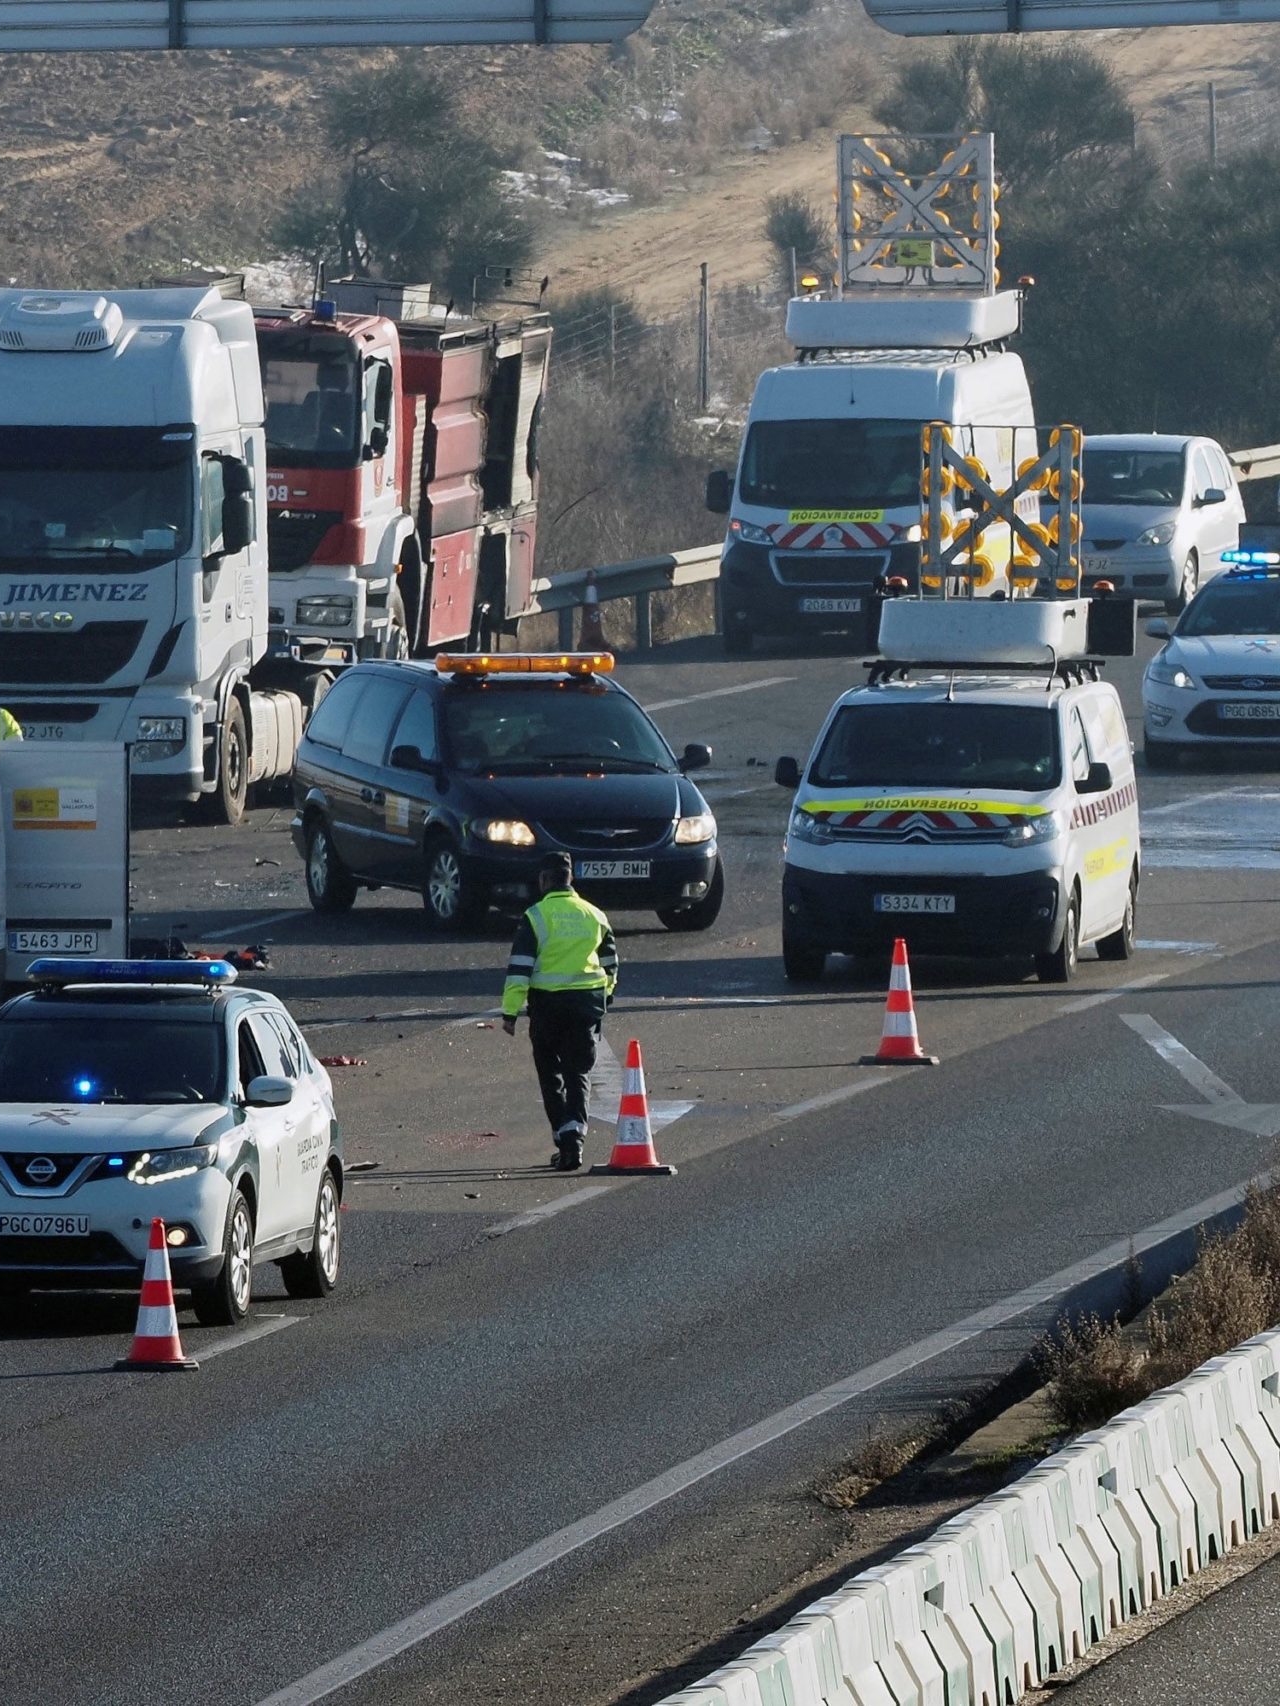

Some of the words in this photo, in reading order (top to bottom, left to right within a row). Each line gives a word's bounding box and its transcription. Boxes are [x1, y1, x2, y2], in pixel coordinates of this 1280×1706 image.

[3, 583, 149, 605] JIMENEZ
[583, 863, 617, 876] 7557
[623, 863, 648, 876] BMH
[924, 896, 950, 910] KTY
[20, 934, 58, 948] 5463
[64, 934, 92, 948] JPR
